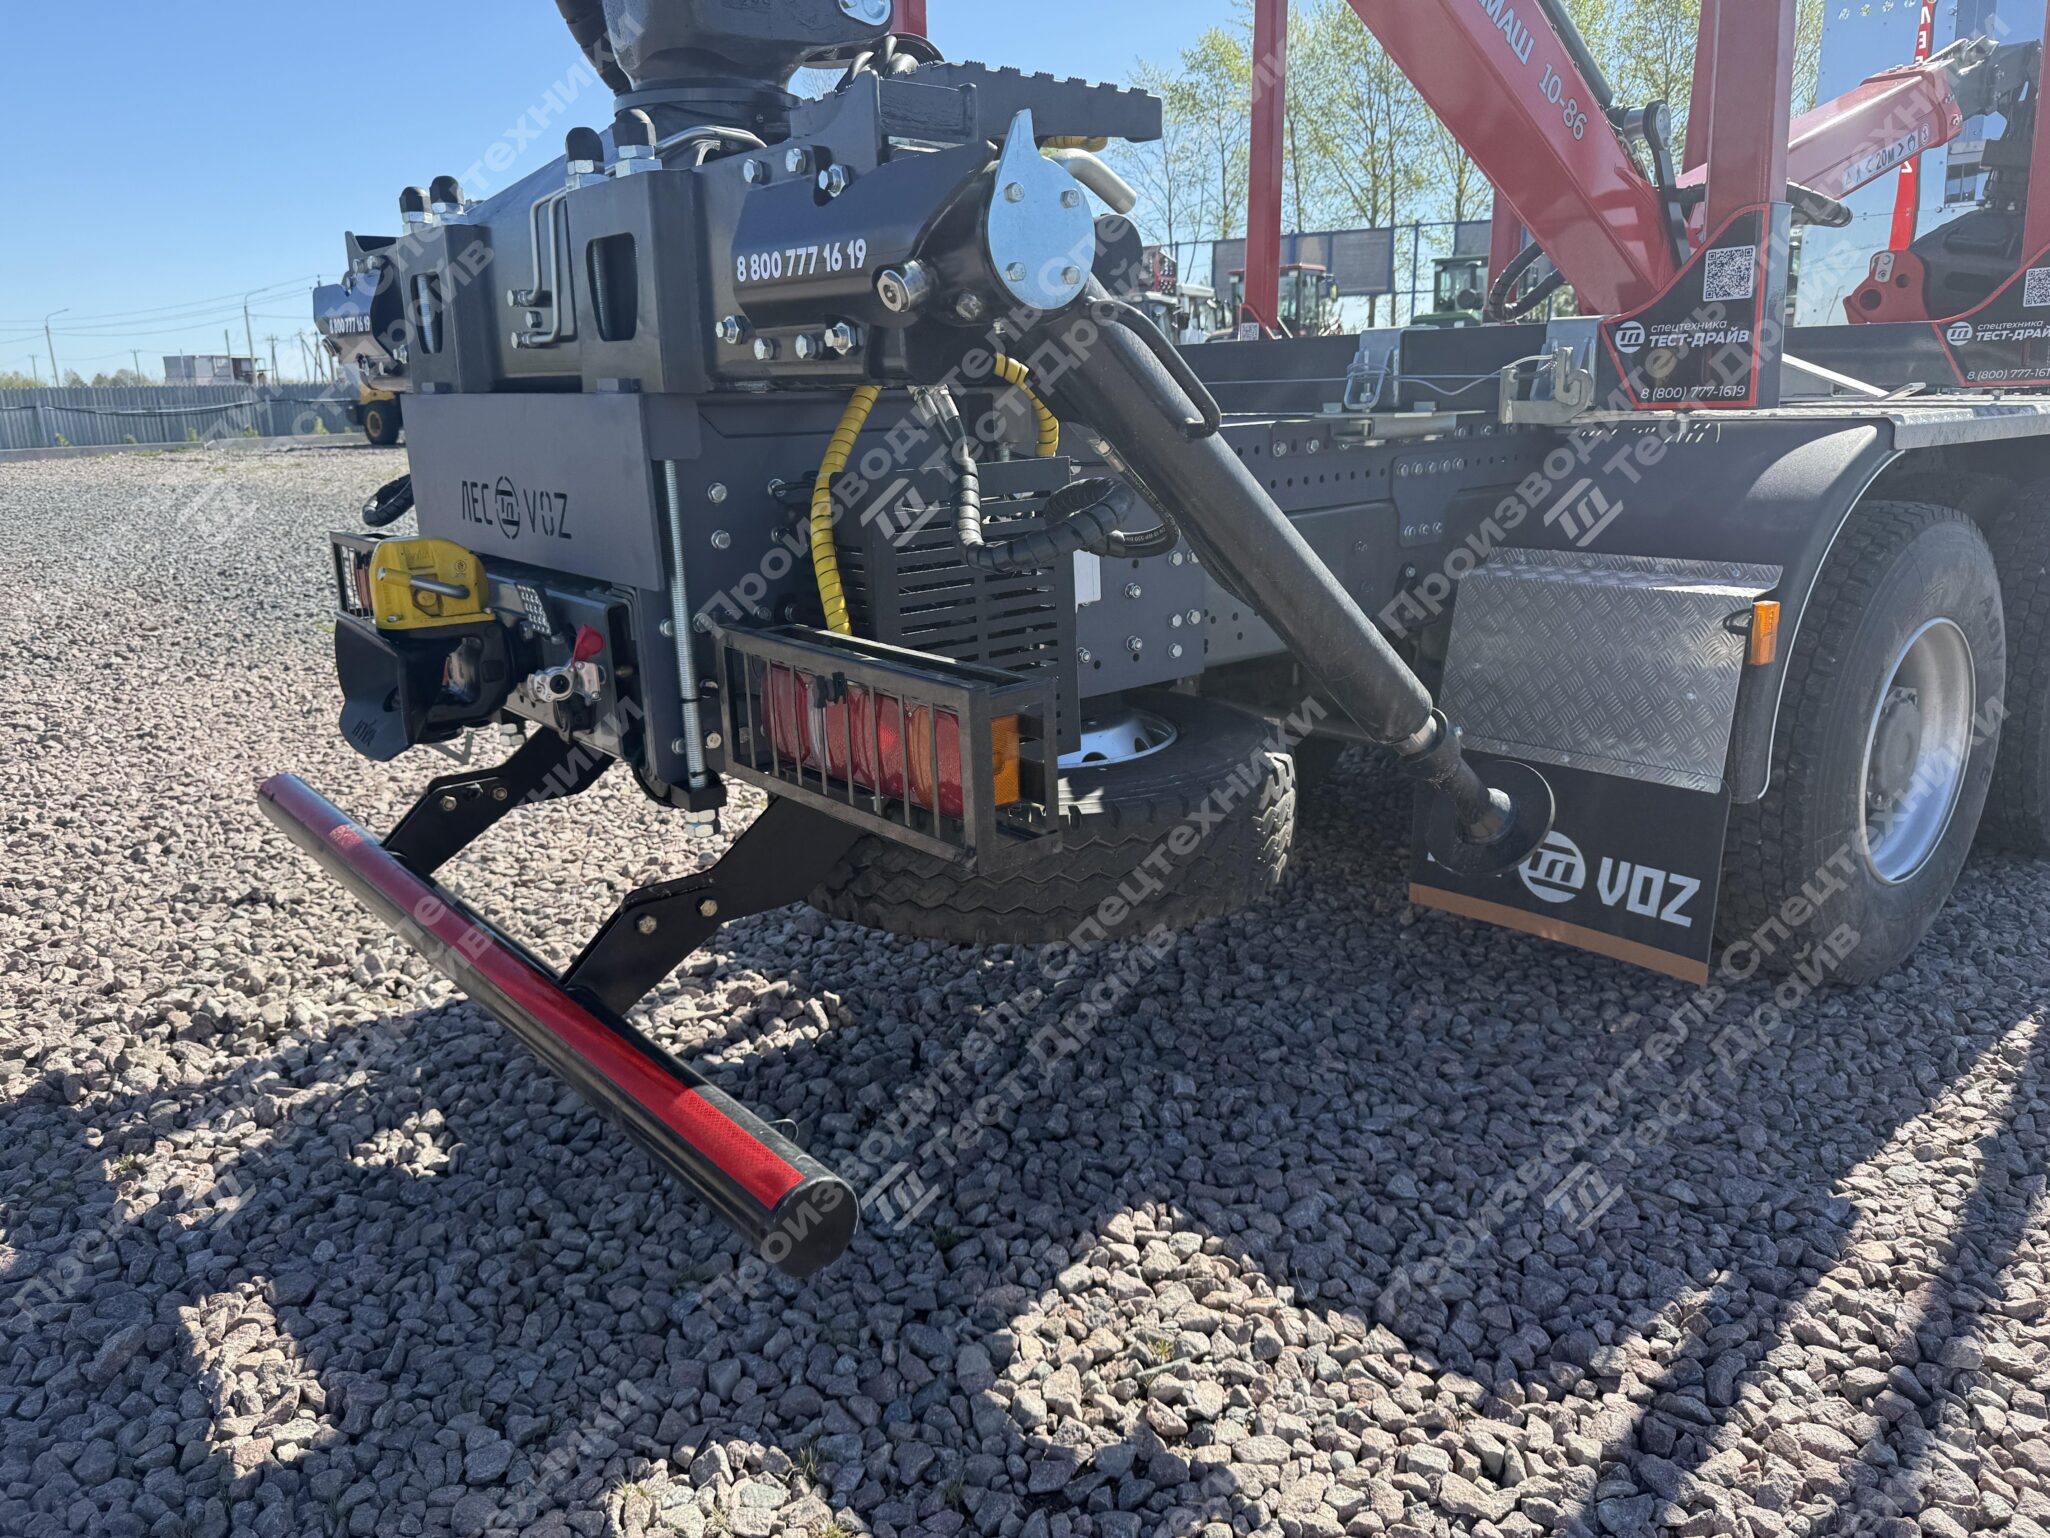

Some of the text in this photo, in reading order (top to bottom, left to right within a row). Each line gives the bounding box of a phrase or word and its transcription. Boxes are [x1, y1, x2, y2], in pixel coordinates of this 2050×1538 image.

[1538, 63, 1588, 141] 10-86
[736, 238, 866, 282] 8 800 777 16 19
[1651, 320, 1727, 333] спецтехника
[1978, 320, 2044, 331] спецтехника
[1650, 327, 1749, 348] ТЕСТ-ДРАЙВ
[1967, 371, 1975, 380] 8
[1977, 370, 2008, 380] (800)
[1640, 385, 1746, 400] 8 (800) 777-1619
[523, 488, 572, 539] VOZ
[1597, 856, 1701, 928] VOZ
